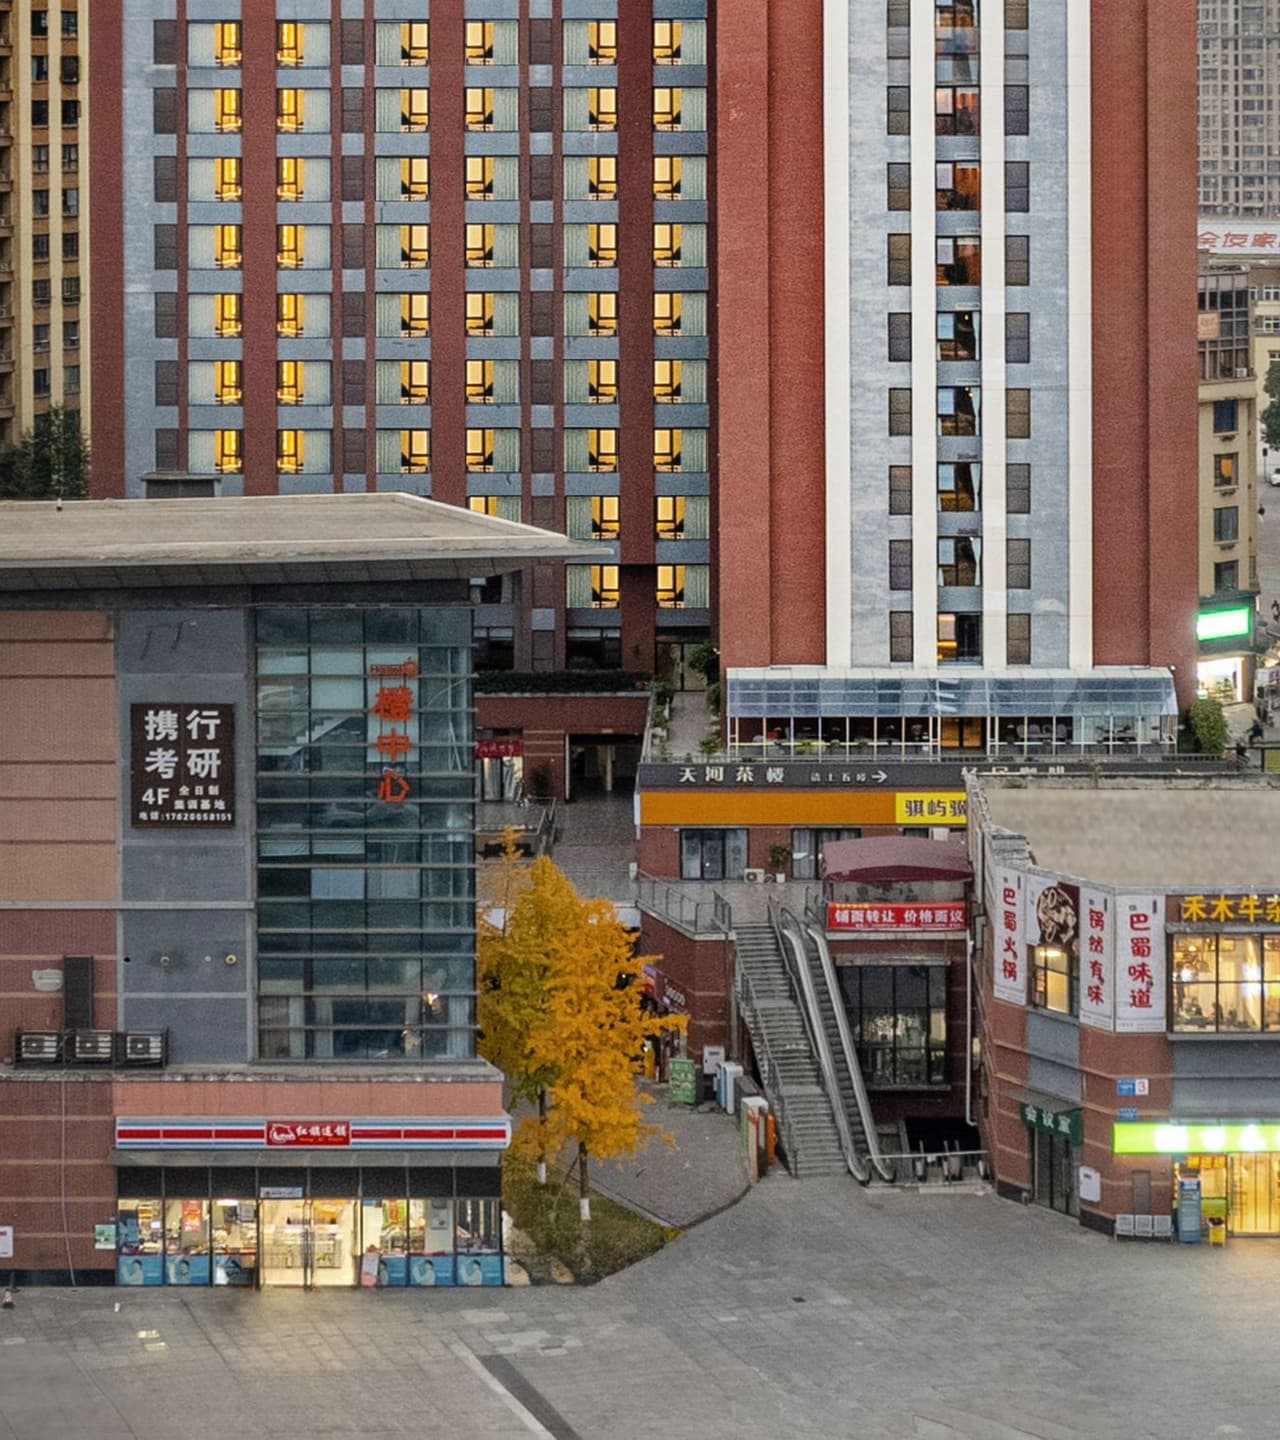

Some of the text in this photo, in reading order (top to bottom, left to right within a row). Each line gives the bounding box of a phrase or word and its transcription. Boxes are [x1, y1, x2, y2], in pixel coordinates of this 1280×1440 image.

[144, 709, 221, 740] 携行
[144, 747, 221, 779] 考研
[142, 788, 170, 805] 4F
[179, 785, 220, 796] 全日制
[1003, 888, 1017, 982] 巴蜀火锅
[1128, 913, 1152, 1009] 巴蜀味道
